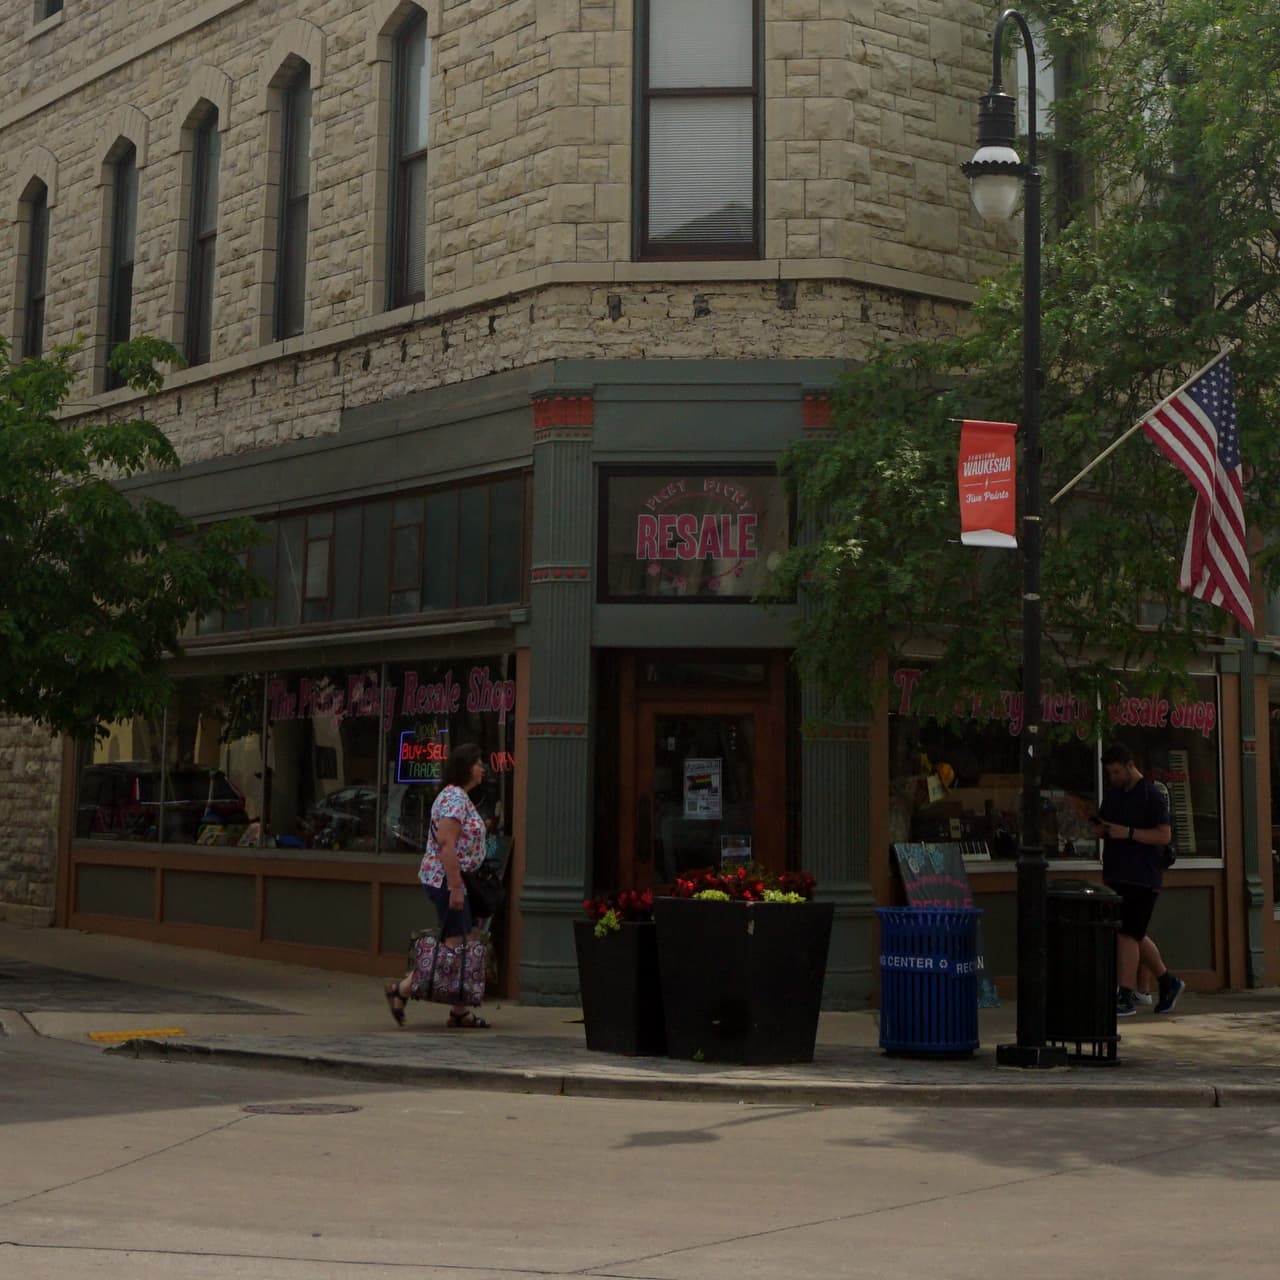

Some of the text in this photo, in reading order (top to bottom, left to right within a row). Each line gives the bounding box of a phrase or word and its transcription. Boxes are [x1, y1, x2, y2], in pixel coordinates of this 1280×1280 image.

[962, 456, 1011, 477] WAUKESHA
[983, 489, 1009, 502] Points
[636, 513, 758, 560] RESALE
[400, 670, 461, 716] Resale
[466, 665, 517, 725] Shop
[408, 761, 441, 779] TRADE
[887, 955, 934, 969] CENTER
